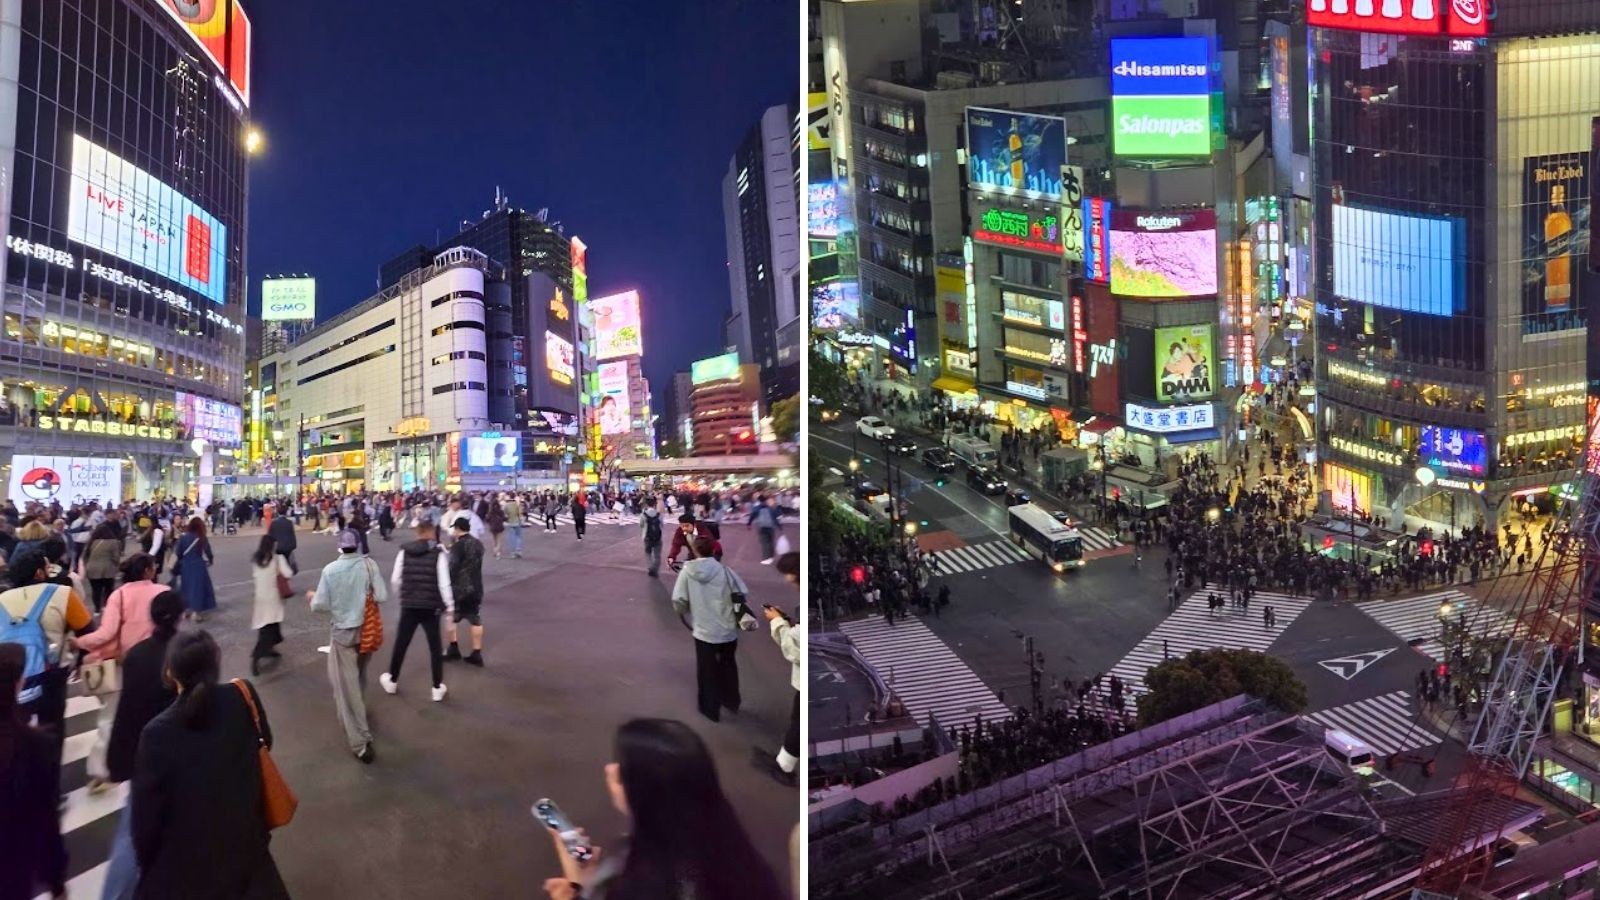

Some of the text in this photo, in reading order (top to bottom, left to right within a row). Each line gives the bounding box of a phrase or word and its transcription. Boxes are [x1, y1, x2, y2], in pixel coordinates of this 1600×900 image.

[1113, 61, 1207, 76] Hisamitsu
[1119, 113, 1204, 138] Salonpas
[1534, 166, 1584, 183] Blue Label
[86, 184, 125, 213] LIVE
[130, 209, 176, 240] JAPAN
[1137, 216, 1181, 227] Rakuten
[270, 302, 307, 311] GMO
[1162, 378, 1211, 395] DMM
[1131, 409, 1206, 426] 大盛堂書店
[38, 416, 173, 440] STARBUCKS
[1331, 437, 1403, 466] STARBUCKS
